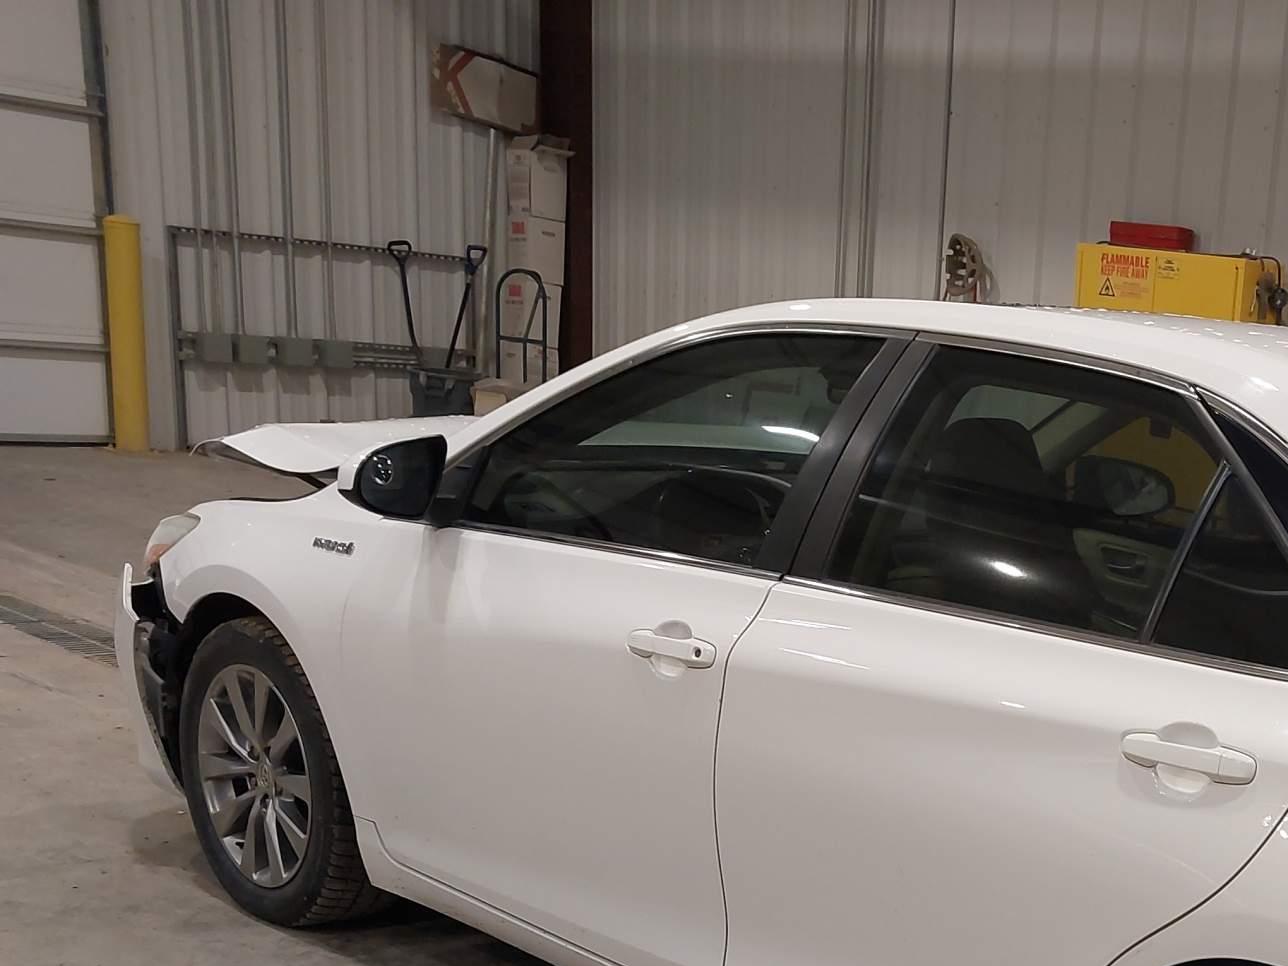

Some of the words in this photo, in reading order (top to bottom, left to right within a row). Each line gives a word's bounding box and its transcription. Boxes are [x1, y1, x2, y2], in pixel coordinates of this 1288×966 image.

[1100, 252, 1151, 269] FLAMMABLE
[1100, 264, 1115, 276] KEEP
[1116, 265, 1130, 278] FIRE
[1131, 267, 1149, 280] AWAY
